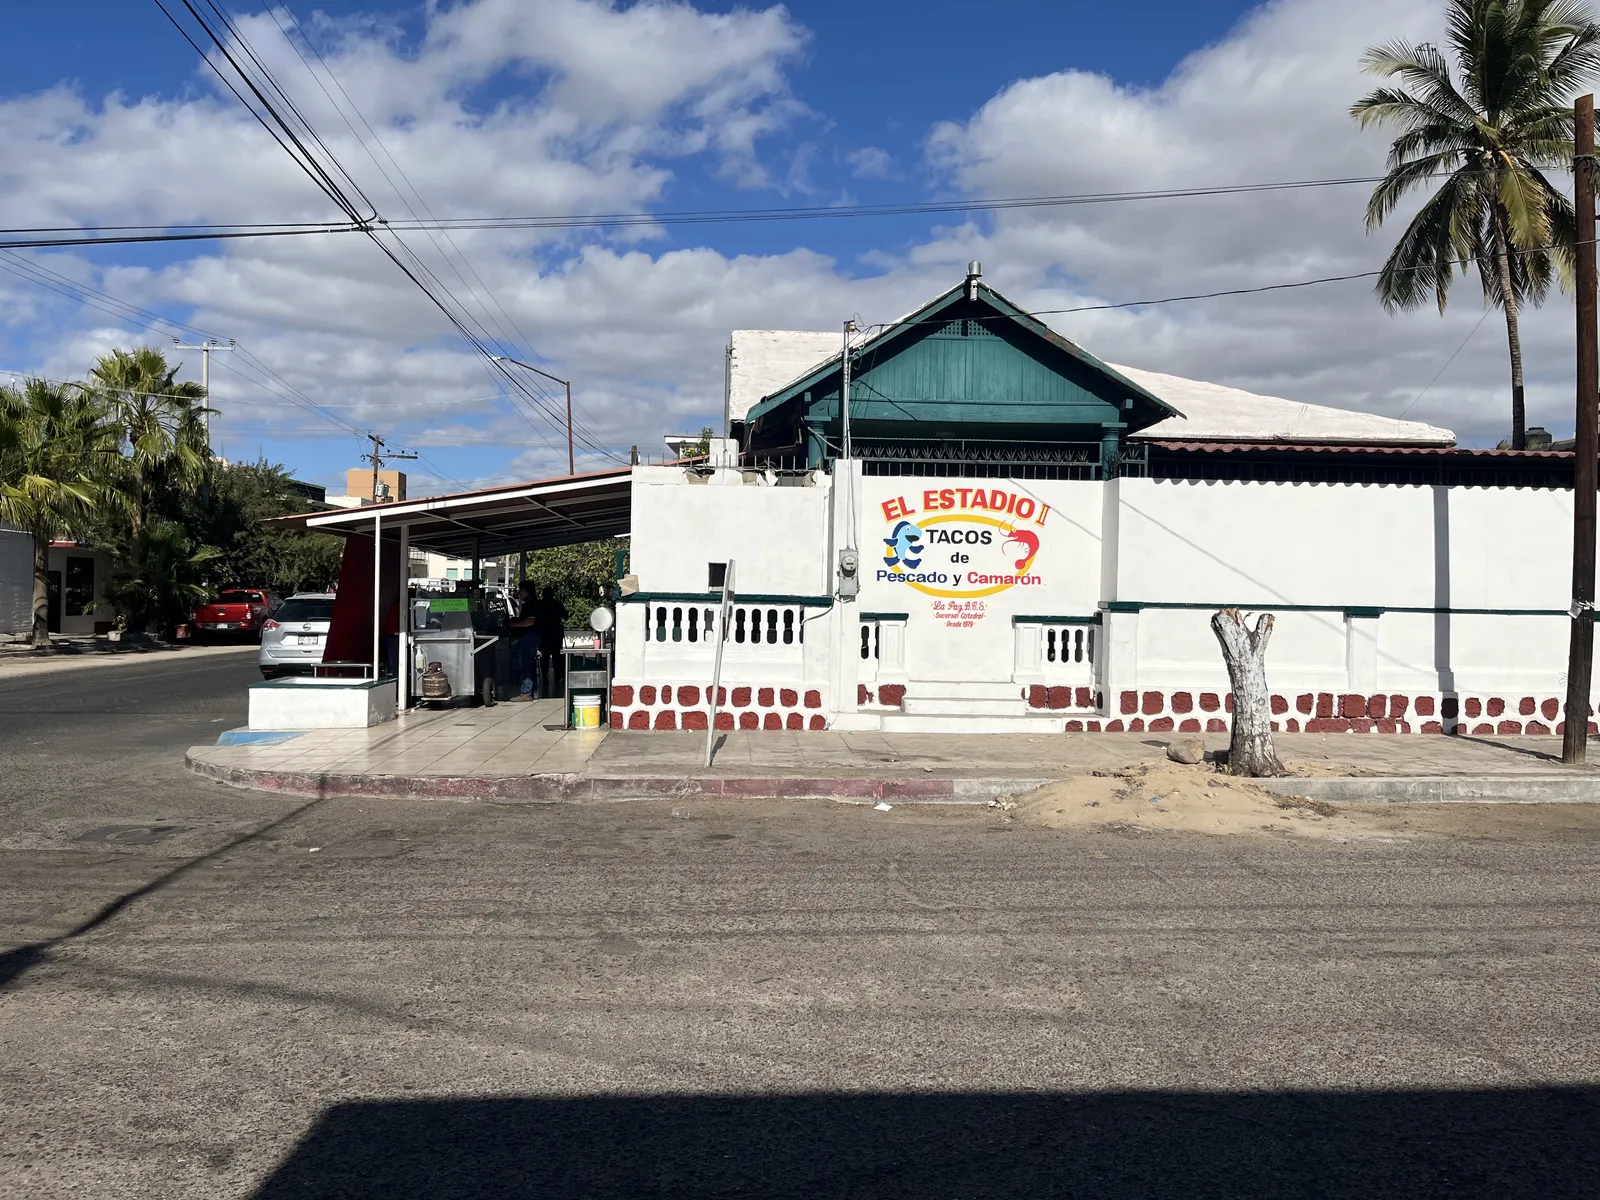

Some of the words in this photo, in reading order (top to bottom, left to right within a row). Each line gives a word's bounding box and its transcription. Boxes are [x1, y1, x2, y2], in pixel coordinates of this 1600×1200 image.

[880, 496, 916, 524] EL
[922, 488, 1036, 521] ESTADIO
[925, 529, 993, 545] TACOS
[950, 552, 970, 564] de
[876, 570, 948, 584] Pescado
[953, 574, 962, 587] y
[967, 571, 1042, 586] Camarón
[933, 601, 945, 611] La
